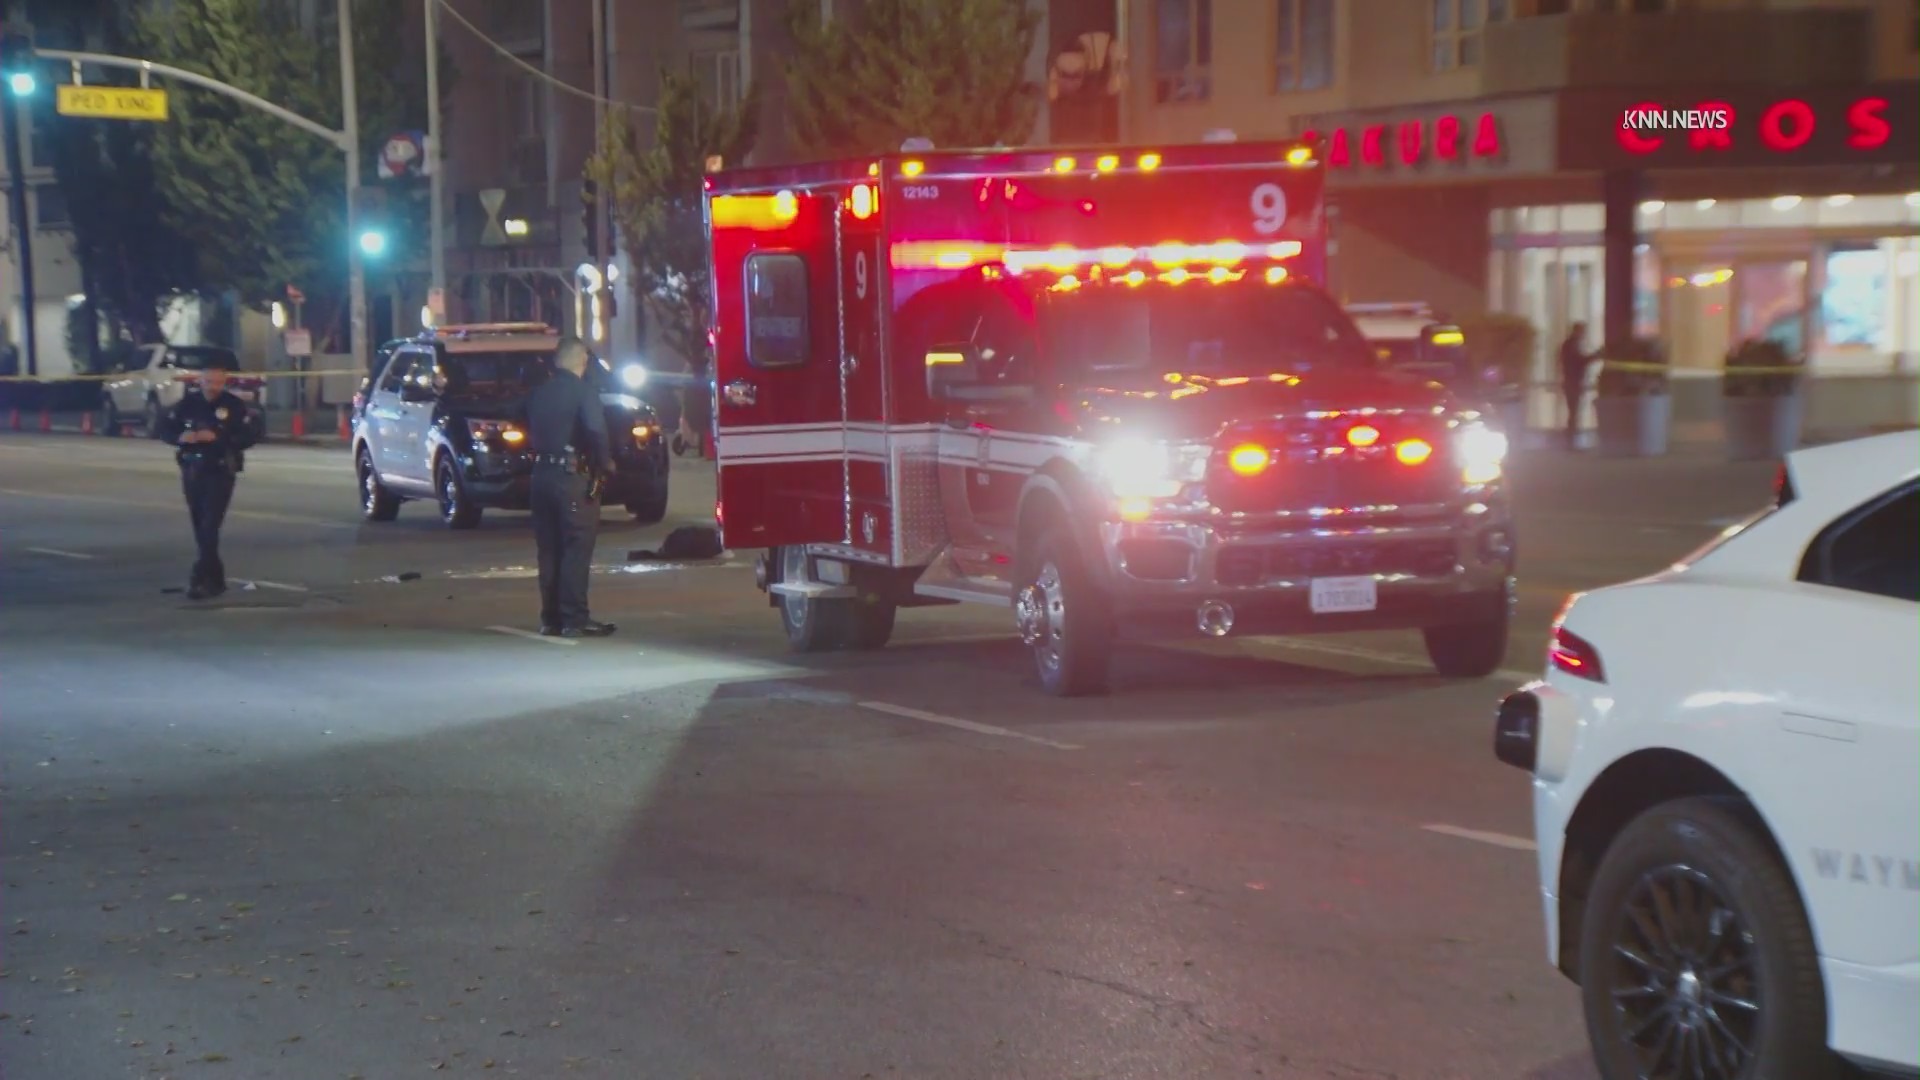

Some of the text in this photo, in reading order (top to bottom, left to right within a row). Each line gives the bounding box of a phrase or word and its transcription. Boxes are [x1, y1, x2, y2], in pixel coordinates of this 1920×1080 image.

[70, 92, 154, 112] PED XING
[1302, 112, 1500, 168] AKURA
[903, 185, 939, 199] 12143
[1250, 183, 1287, 234] 9
[855, 250, 867, 300] 9
